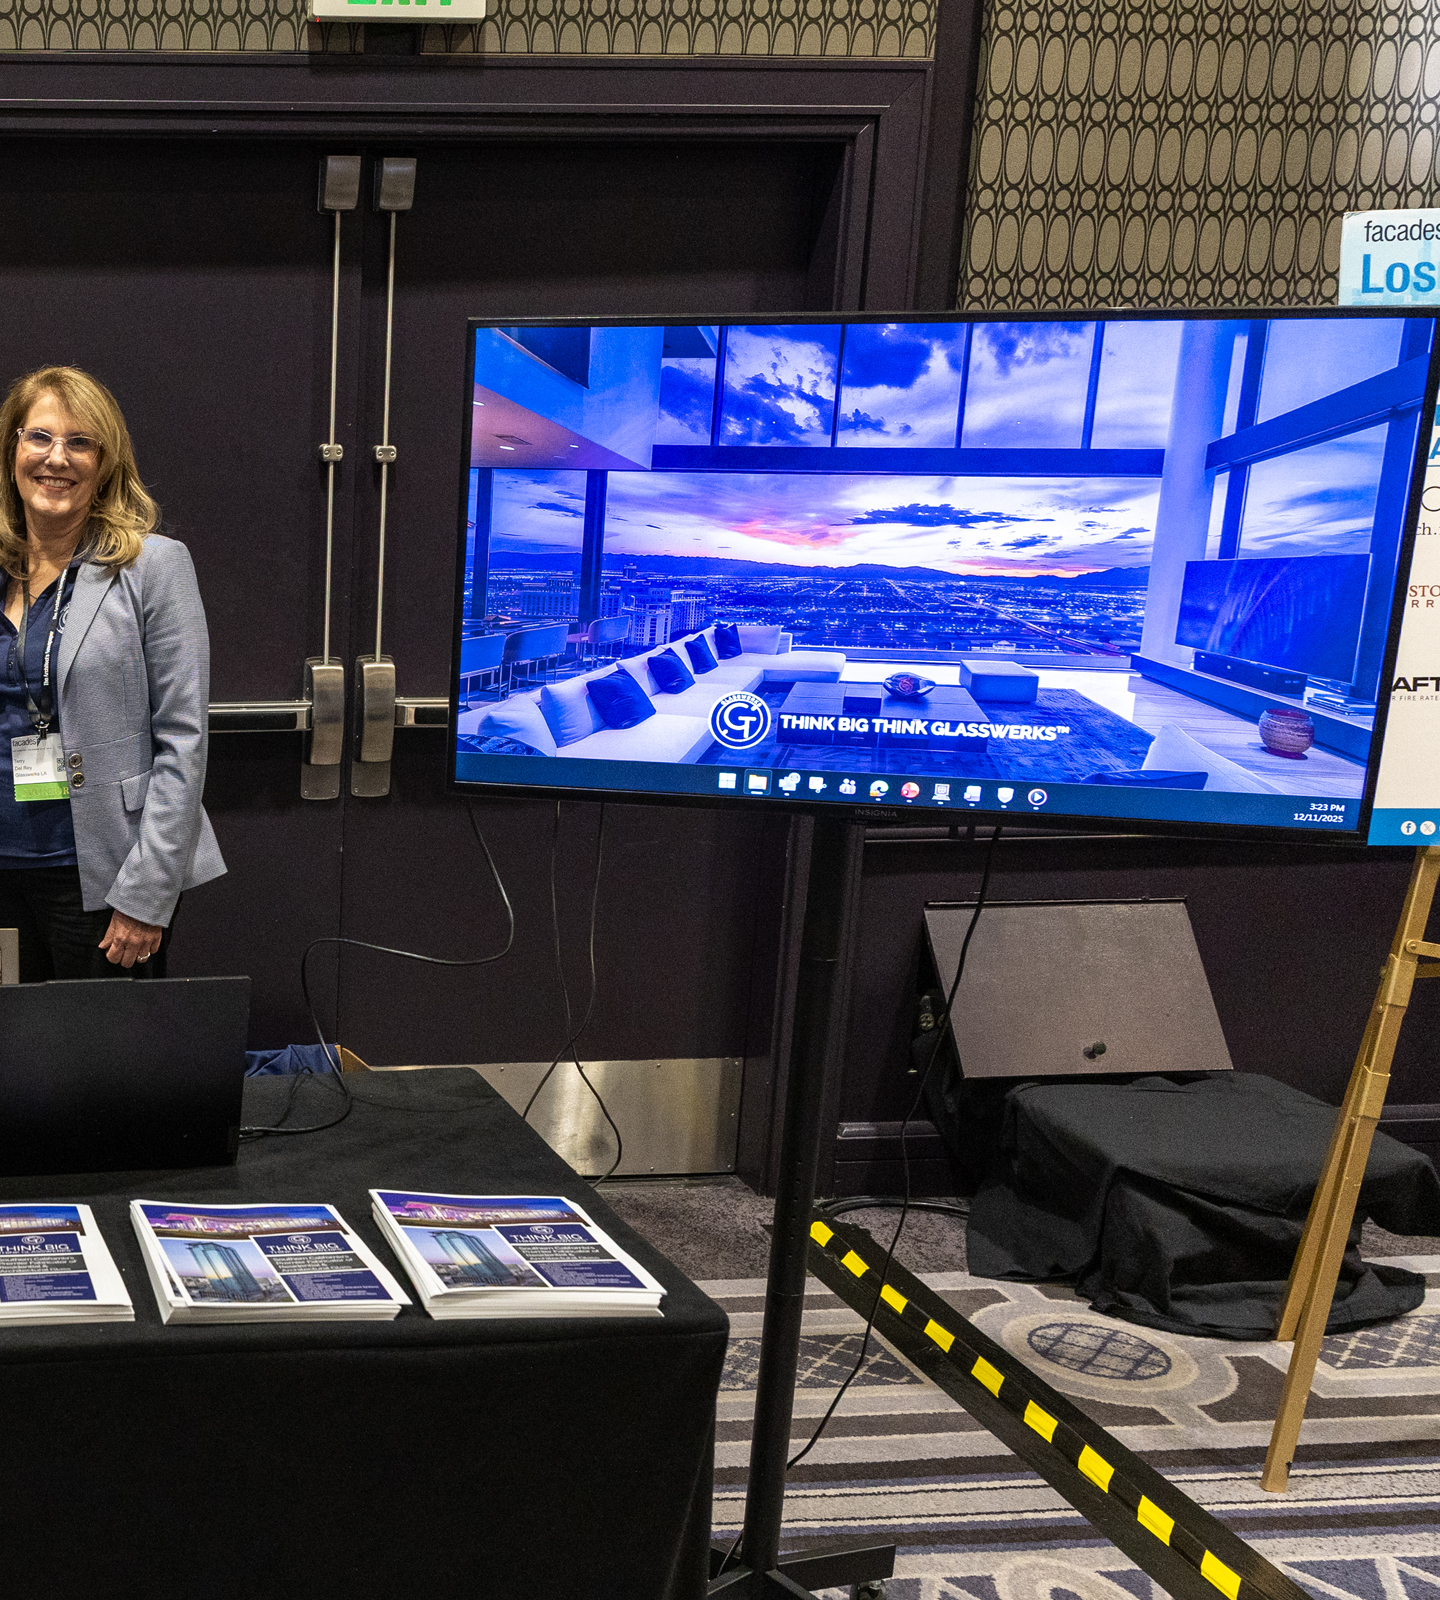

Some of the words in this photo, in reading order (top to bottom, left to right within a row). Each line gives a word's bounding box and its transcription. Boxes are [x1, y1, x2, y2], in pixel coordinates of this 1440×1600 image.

[1362, 254, 1436, 293] Los
[780, 714, 835, 732] THINK
[838, 717, 868, 732] BIG
[872, 719, 928, 735] THINK
[1310, 803, 1328, 811] 3:23
[1330, 804, 1345, 812] PM
[855, 809, 897, 817] INSIGNIA
[1293, 813, 1343, 822] 12/11/2025
[510, 1234, 557, 1242] THINK
[266, 1244, 312, 1252] THINK
[314, 1242, 339, 1250] BIG
